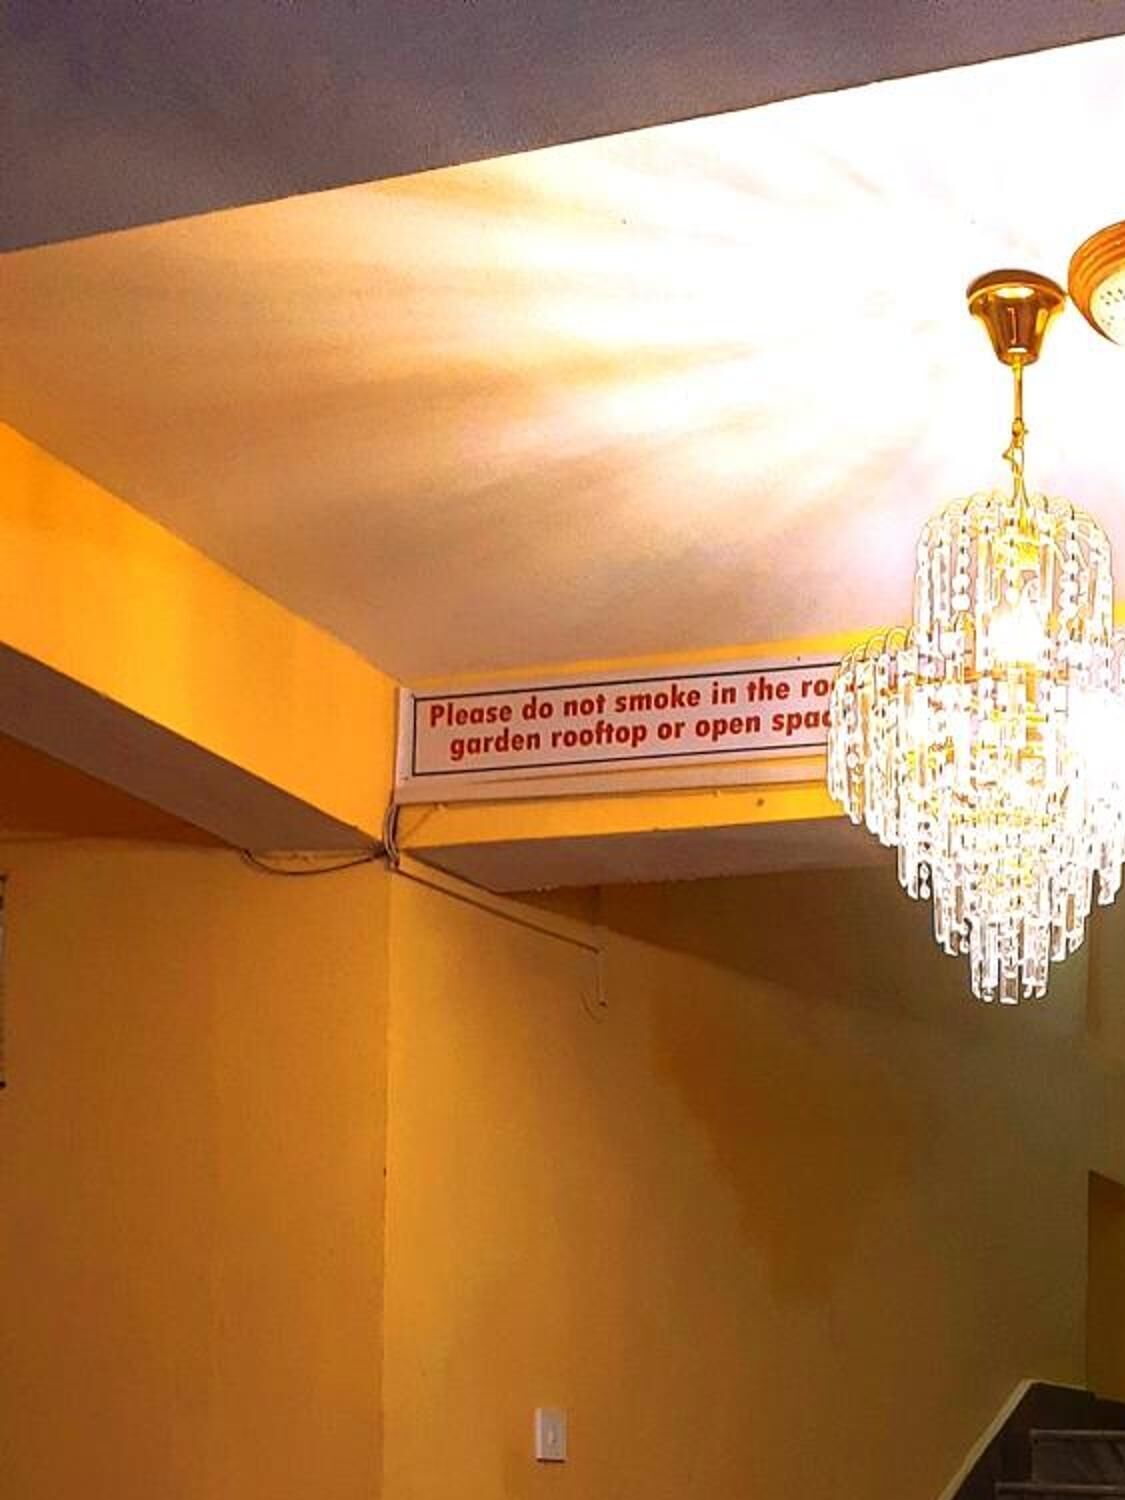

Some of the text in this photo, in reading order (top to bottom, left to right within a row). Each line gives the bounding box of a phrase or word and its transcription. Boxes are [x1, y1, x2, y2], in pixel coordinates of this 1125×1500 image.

[430, 702, 512, 728] Please
[522, 696, 553, 720] do
[563, 693, 606, 717] not
[615, 684, 701, 713] smoke
[711, 681, 737, 705] in
[747, 676, 790, 702] the
[450, 710, 832, 761] garden rooftop or open spac
